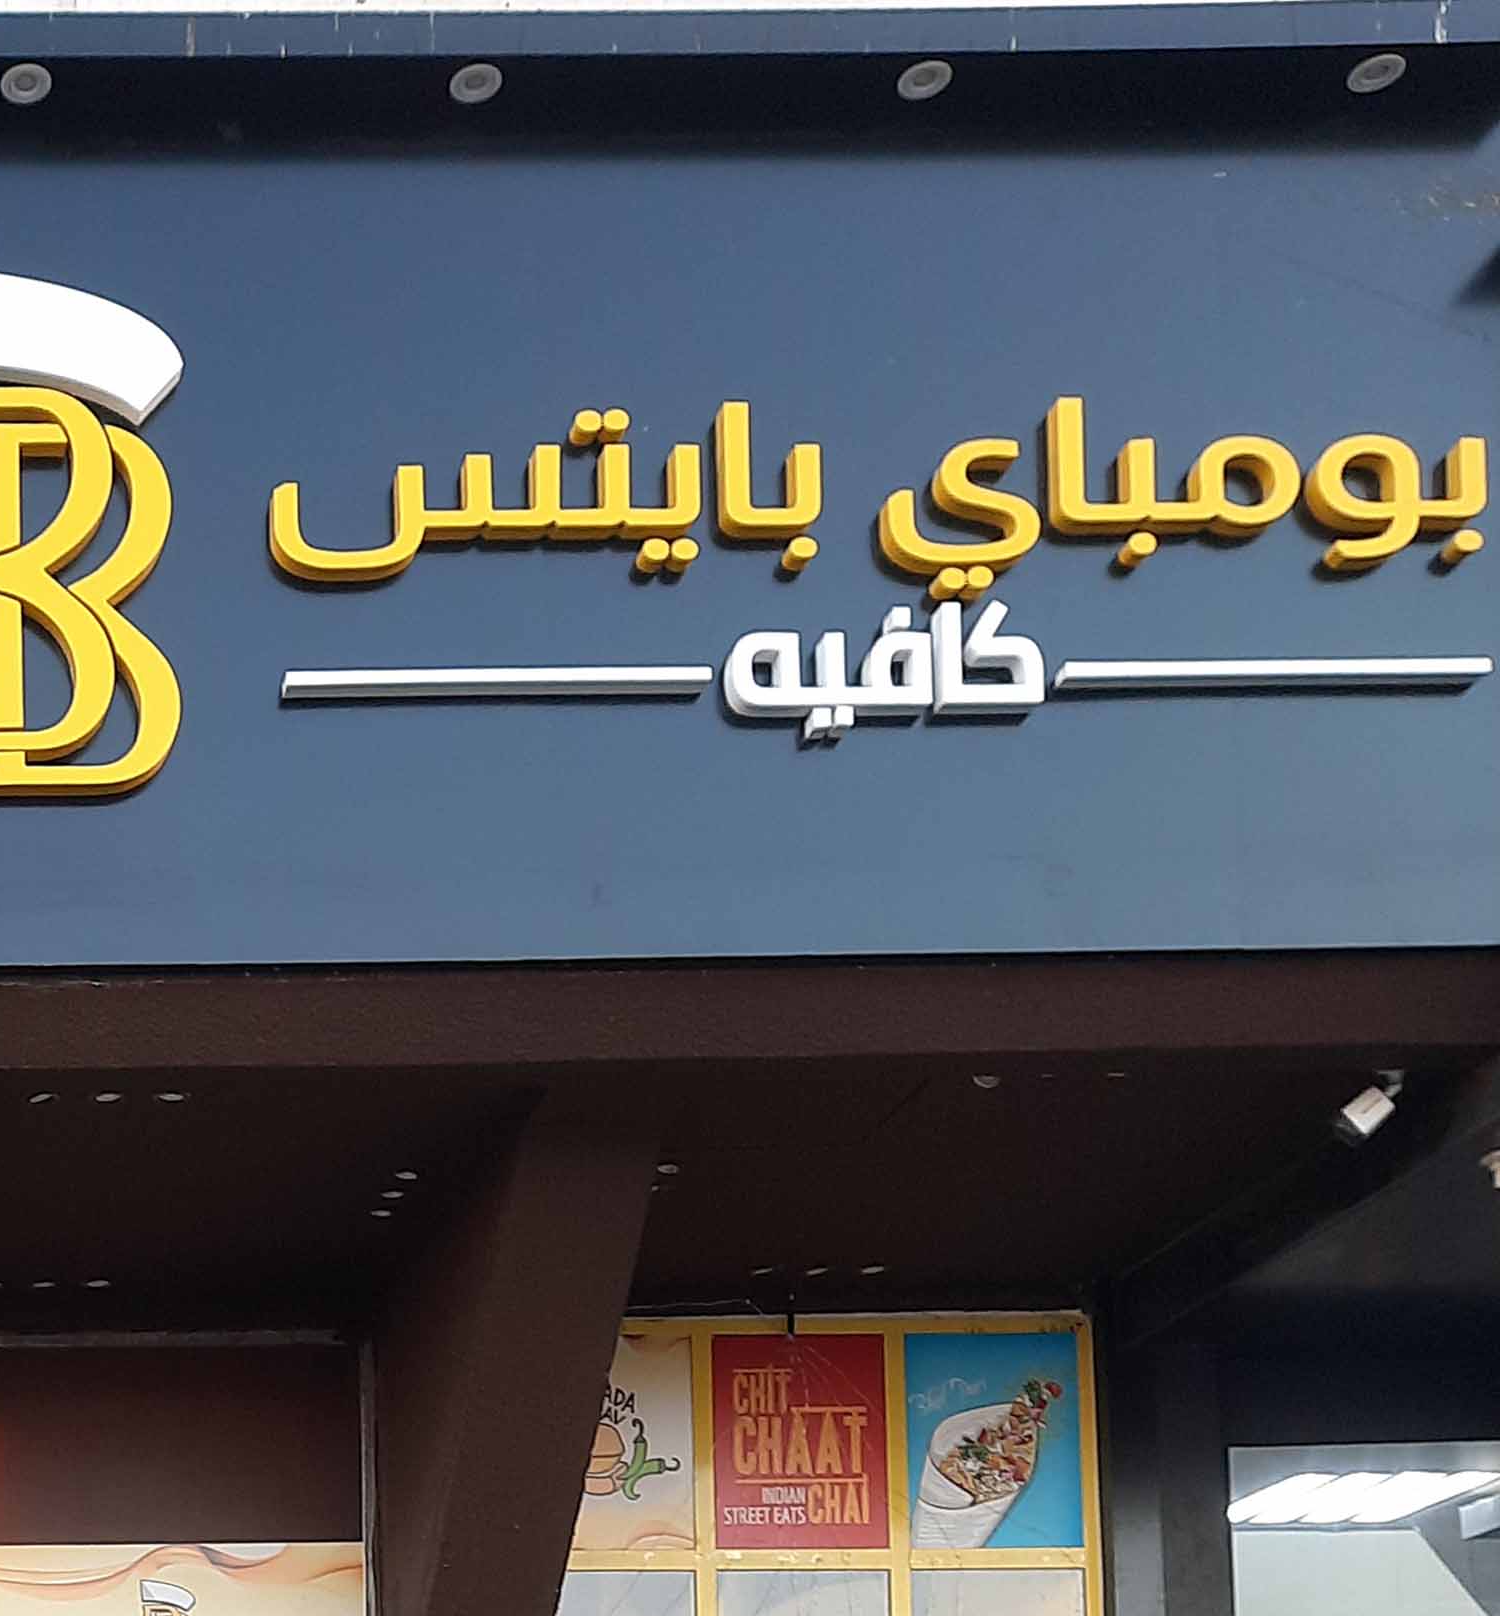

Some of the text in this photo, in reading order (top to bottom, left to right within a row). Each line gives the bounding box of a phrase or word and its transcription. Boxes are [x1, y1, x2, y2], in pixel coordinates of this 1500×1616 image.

[267, 396, 1488, 600] بومباي بايتس
[722, 600, 1046, 741] كافيه
[733, 1368, 791, 1415] CHIT
[733, 1406, 868, 1477] CHAAT
[723, 1506, 807, 1525] STREET EATS
[761, 1487, 806, 1505] INDIAN
[807, 1474, 870, 1525] CHAI
